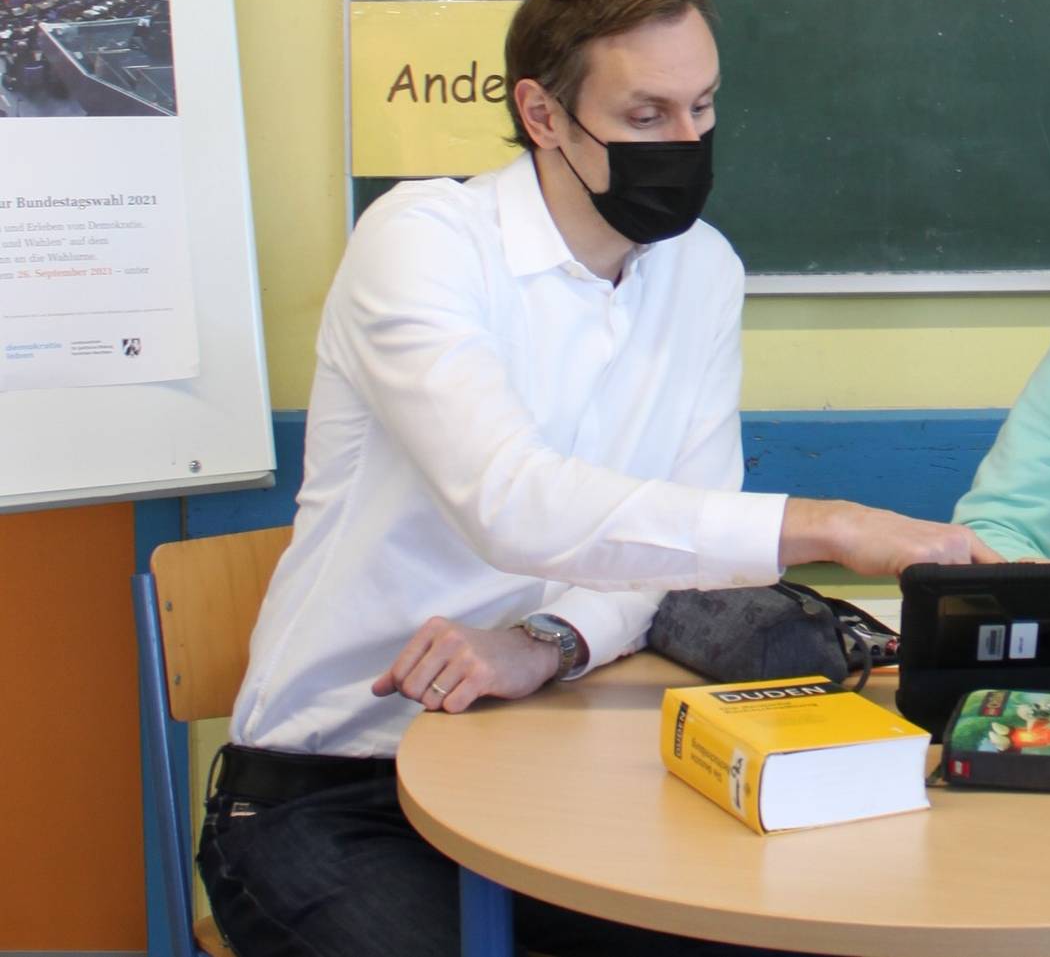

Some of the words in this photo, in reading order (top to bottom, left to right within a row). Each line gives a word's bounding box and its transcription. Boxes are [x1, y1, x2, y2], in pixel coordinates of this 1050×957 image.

[16, 194, 124, 210] Bundestagswahl
[127, 195, 158, 206] 2021
[718, 684, 827, 704] DUDEN
